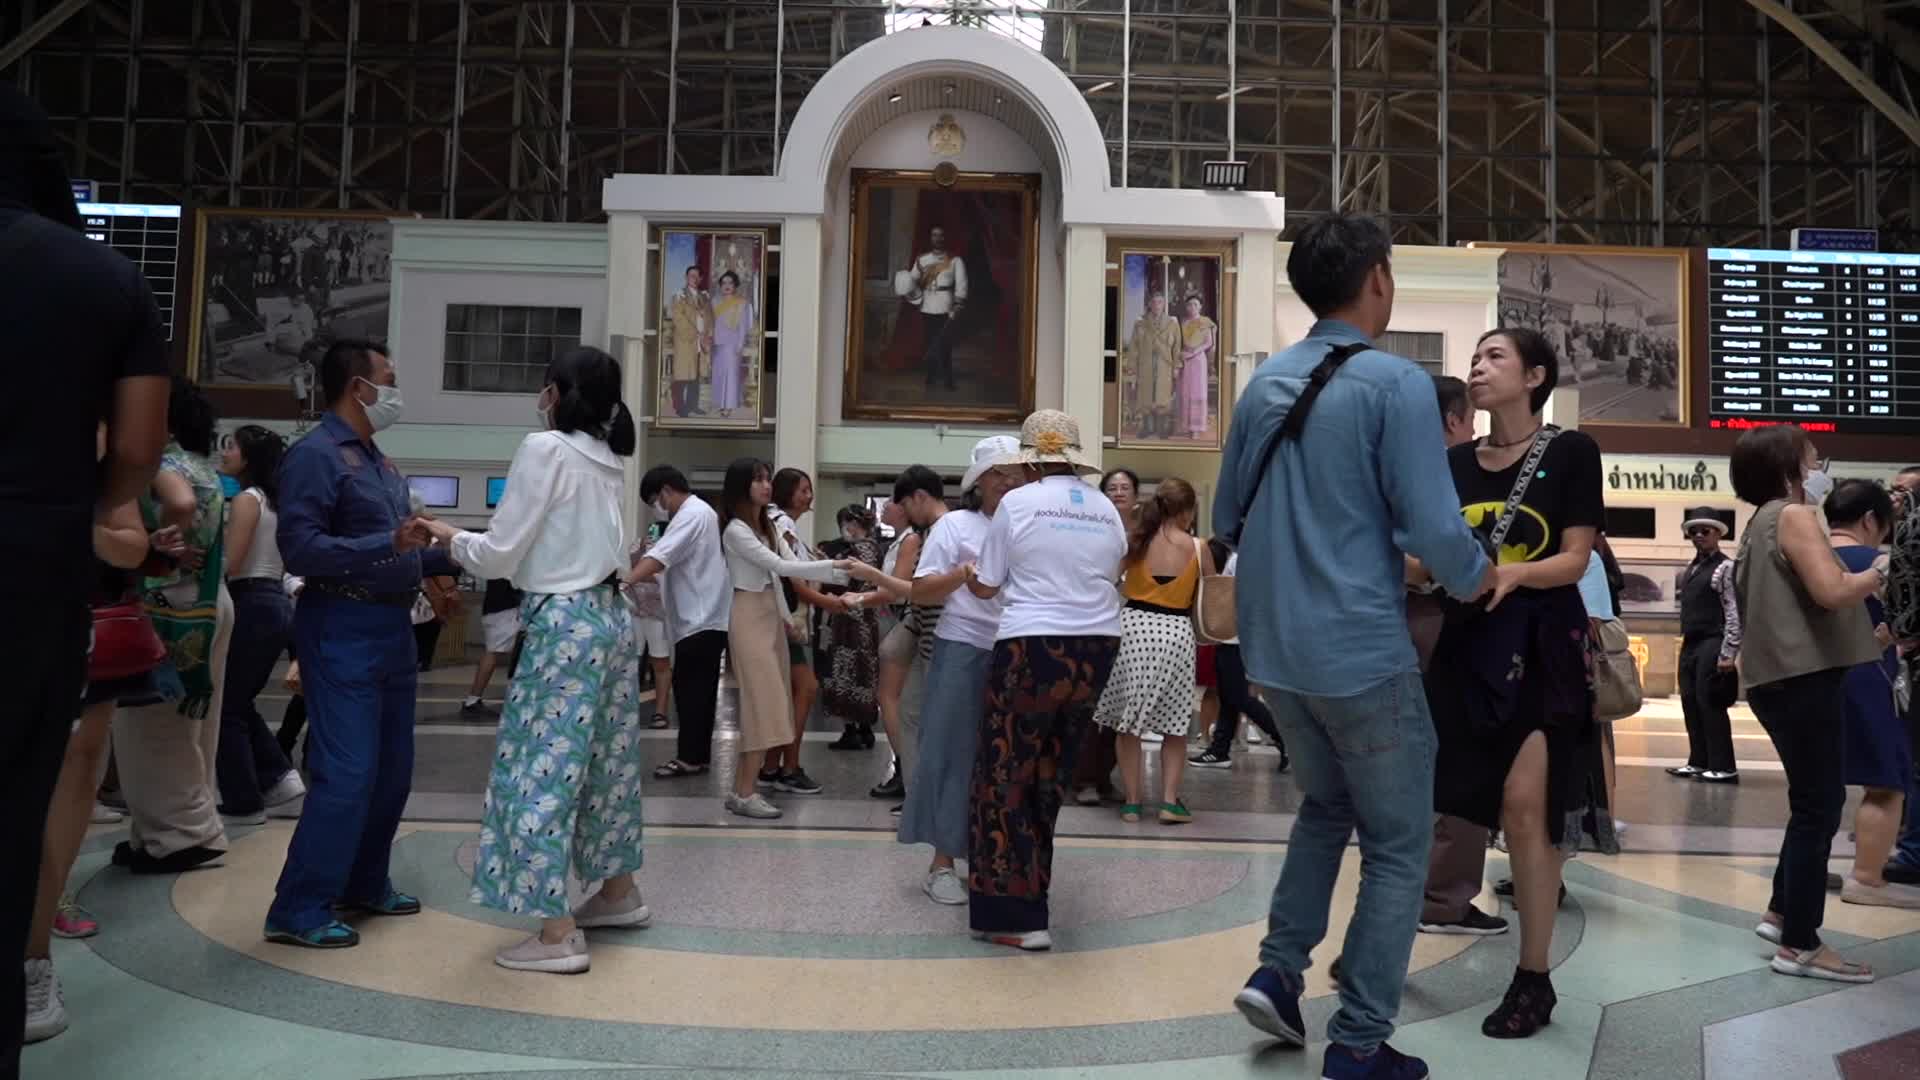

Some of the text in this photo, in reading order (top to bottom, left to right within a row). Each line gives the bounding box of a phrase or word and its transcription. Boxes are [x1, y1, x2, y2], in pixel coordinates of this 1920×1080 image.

[1608, 460, 1717, 491] จำหน่ายตั๋ว
